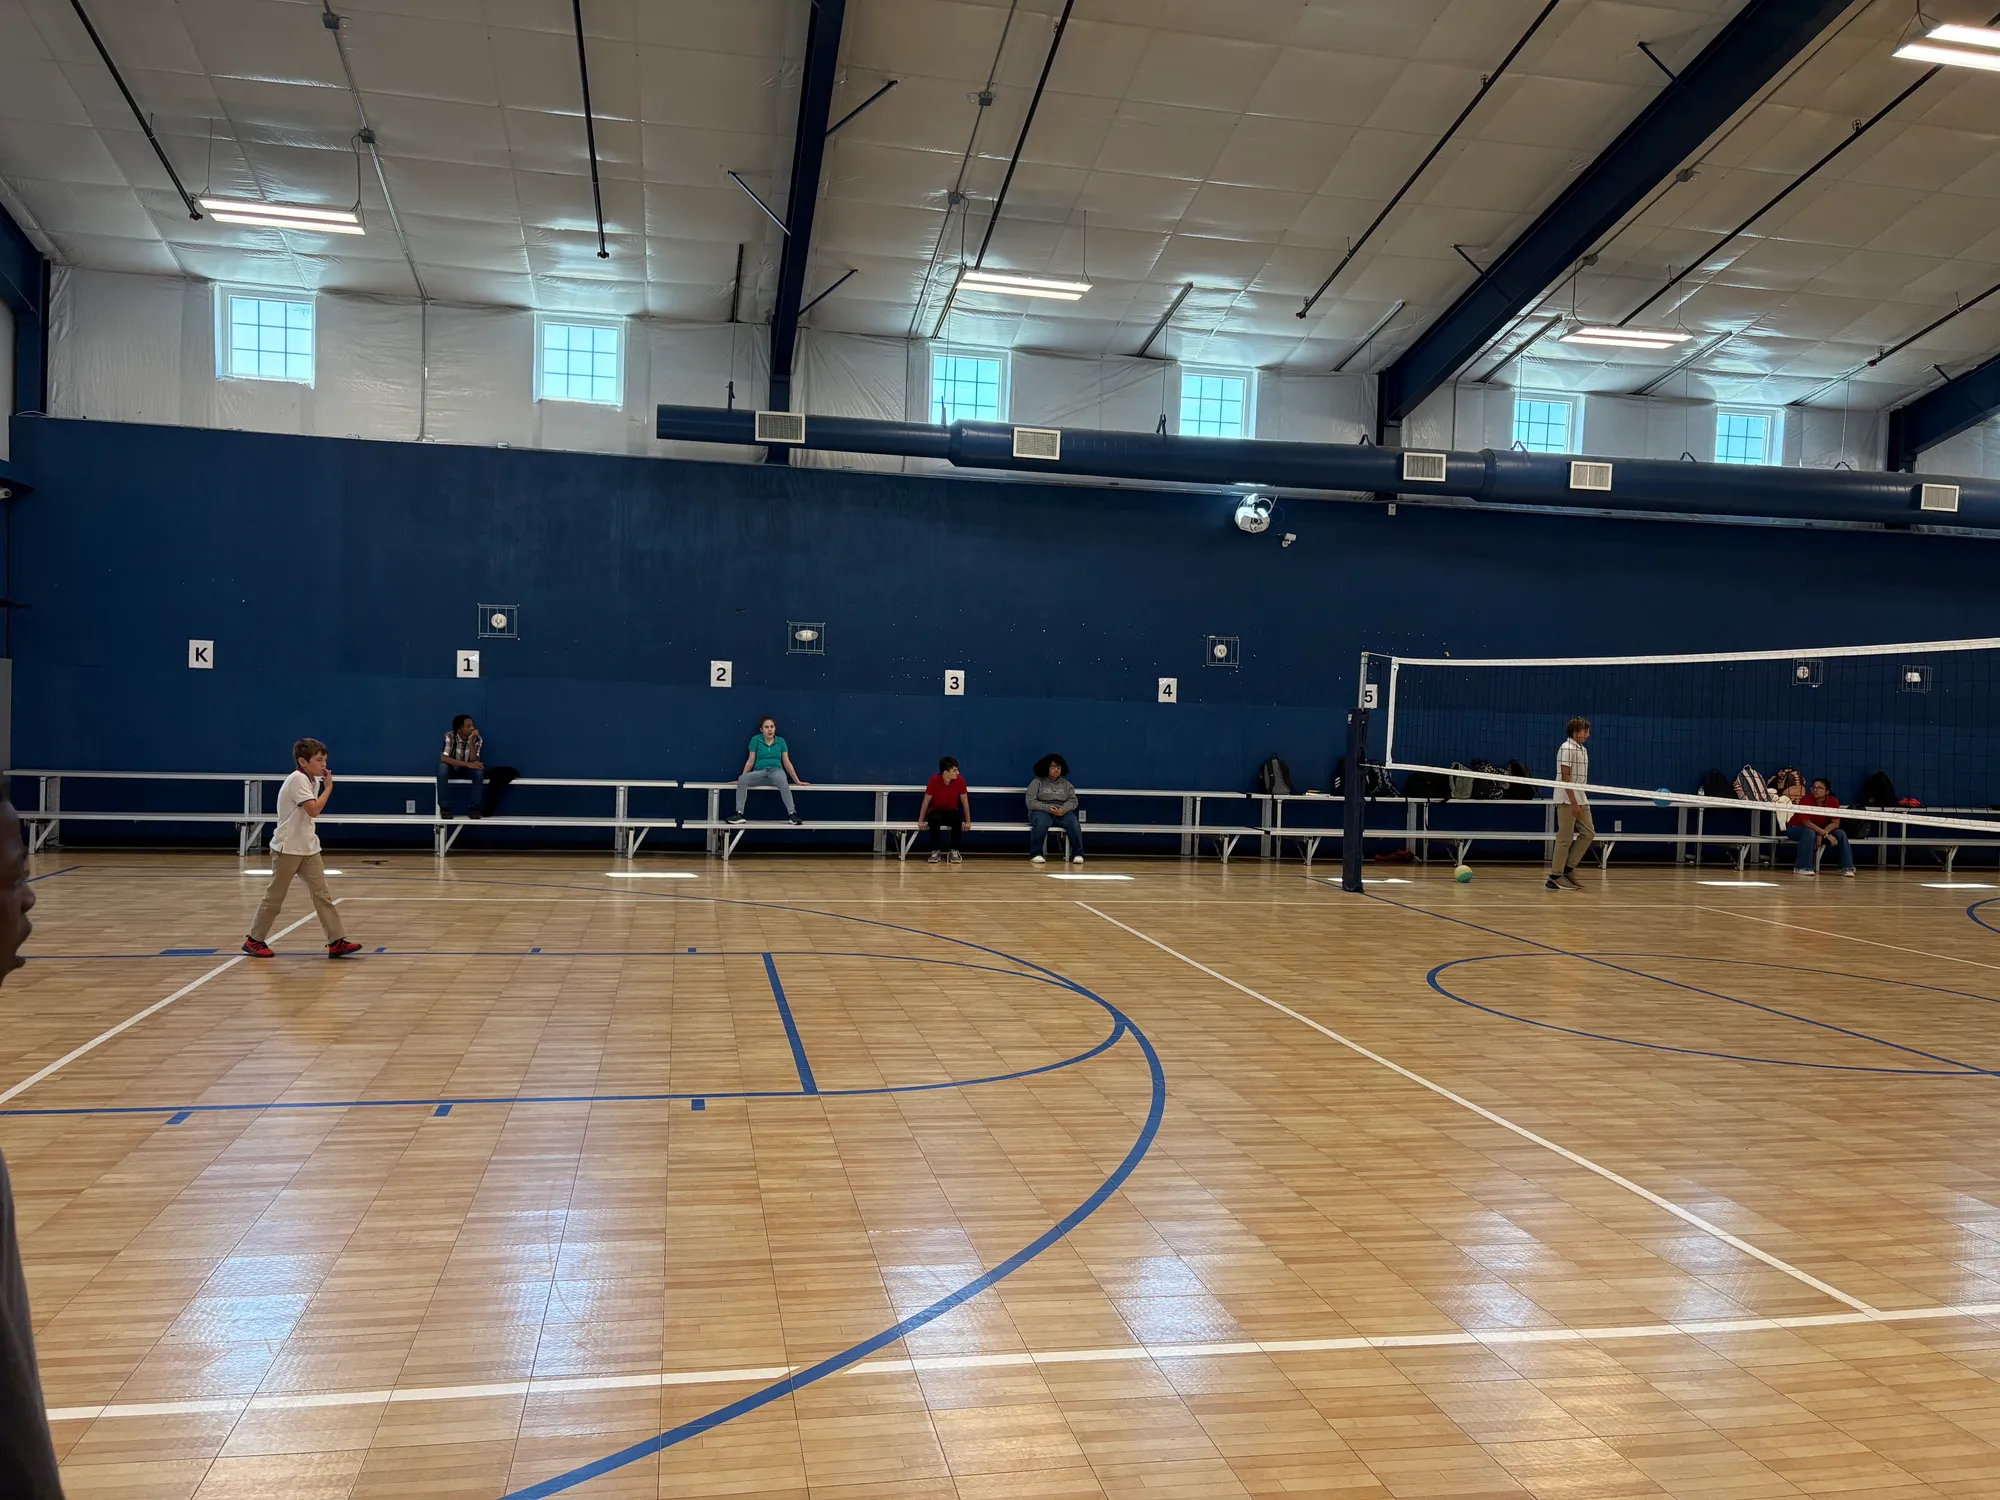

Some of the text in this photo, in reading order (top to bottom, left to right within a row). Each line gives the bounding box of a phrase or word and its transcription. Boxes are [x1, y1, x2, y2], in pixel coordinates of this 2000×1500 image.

[195, 647, 208, 663] K
[463, 658, 474, 672] 1
[716, 667, 727, 682] 2
[949, 676, 960, 691] 3
[1162, 684, 1173, 698] 4
[1364, 690, 1373, 703] 5
